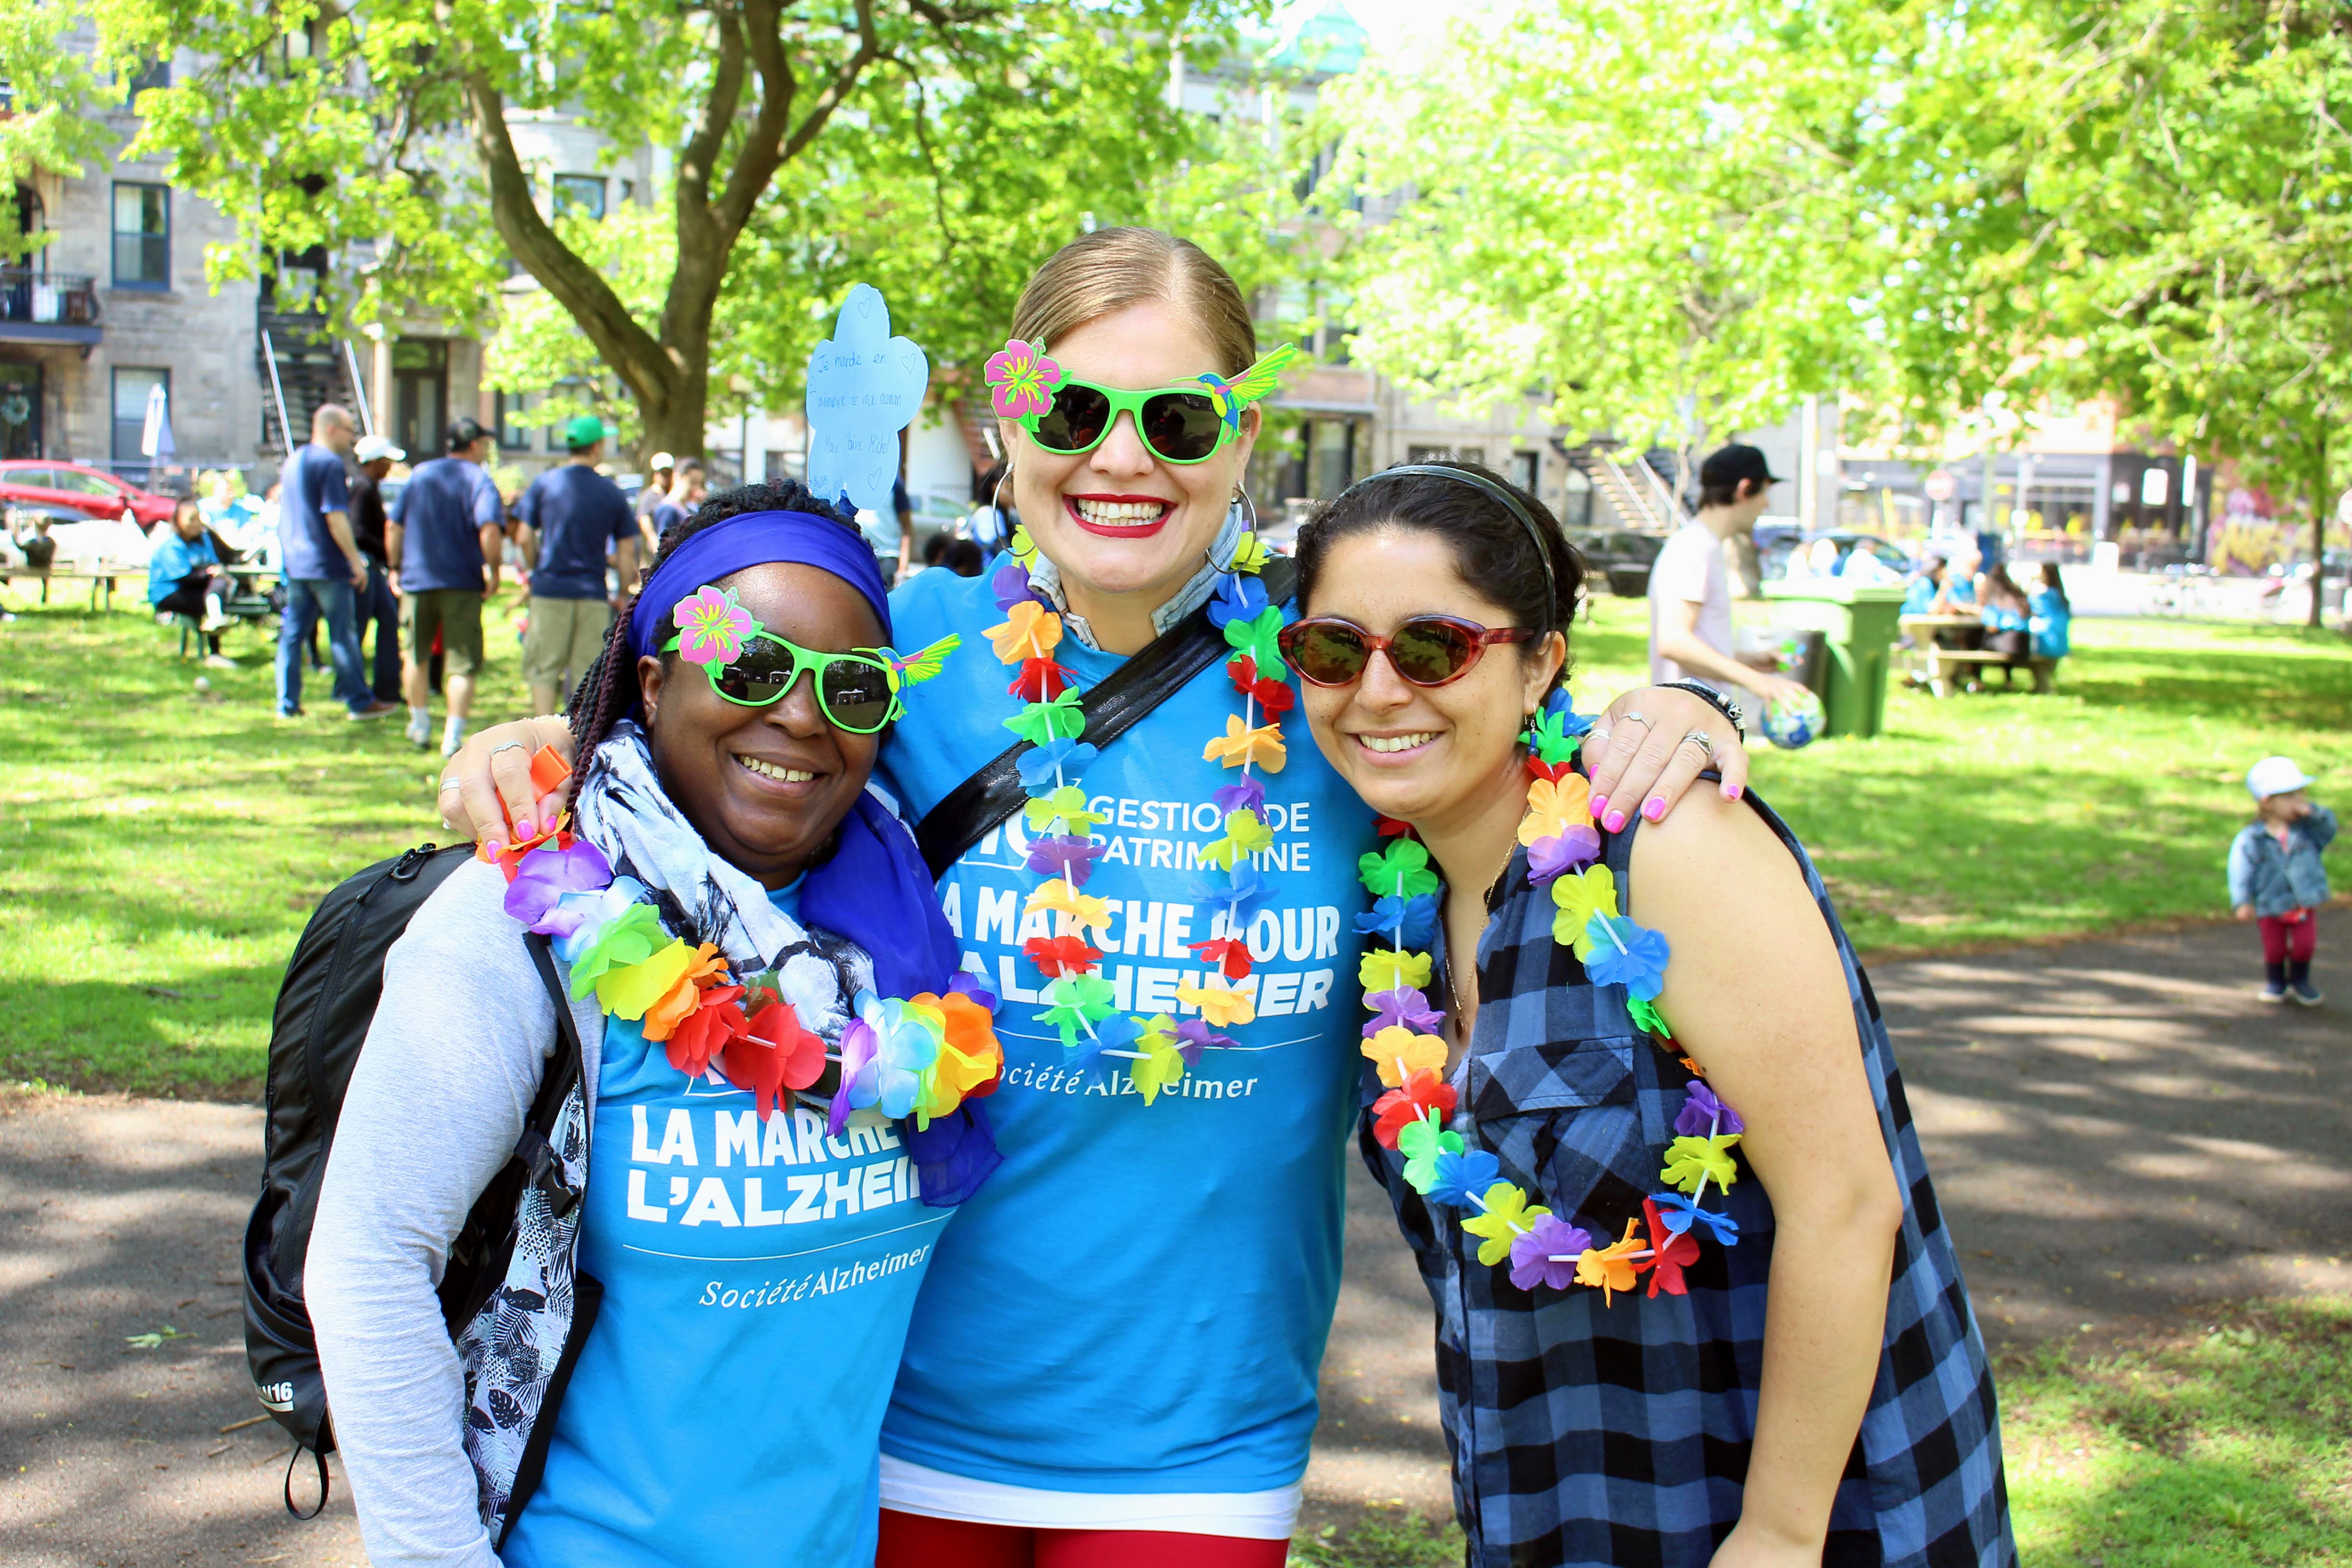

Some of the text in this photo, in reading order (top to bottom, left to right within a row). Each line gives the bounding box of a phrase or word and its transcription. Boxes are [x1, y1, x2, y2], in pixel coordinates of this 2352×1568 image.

[818, 351, 885, 373] Je marche en
[1265, 802, 1310, 833] DE
[1087, 834, 1310, 872] PATRIMINE
[1084, 1070, 1258, 1099] Alzeimer
[631, 1105, 901, 1167] LA MARCHE
[698, 1243, 930, 1309] Société Alzheimer
